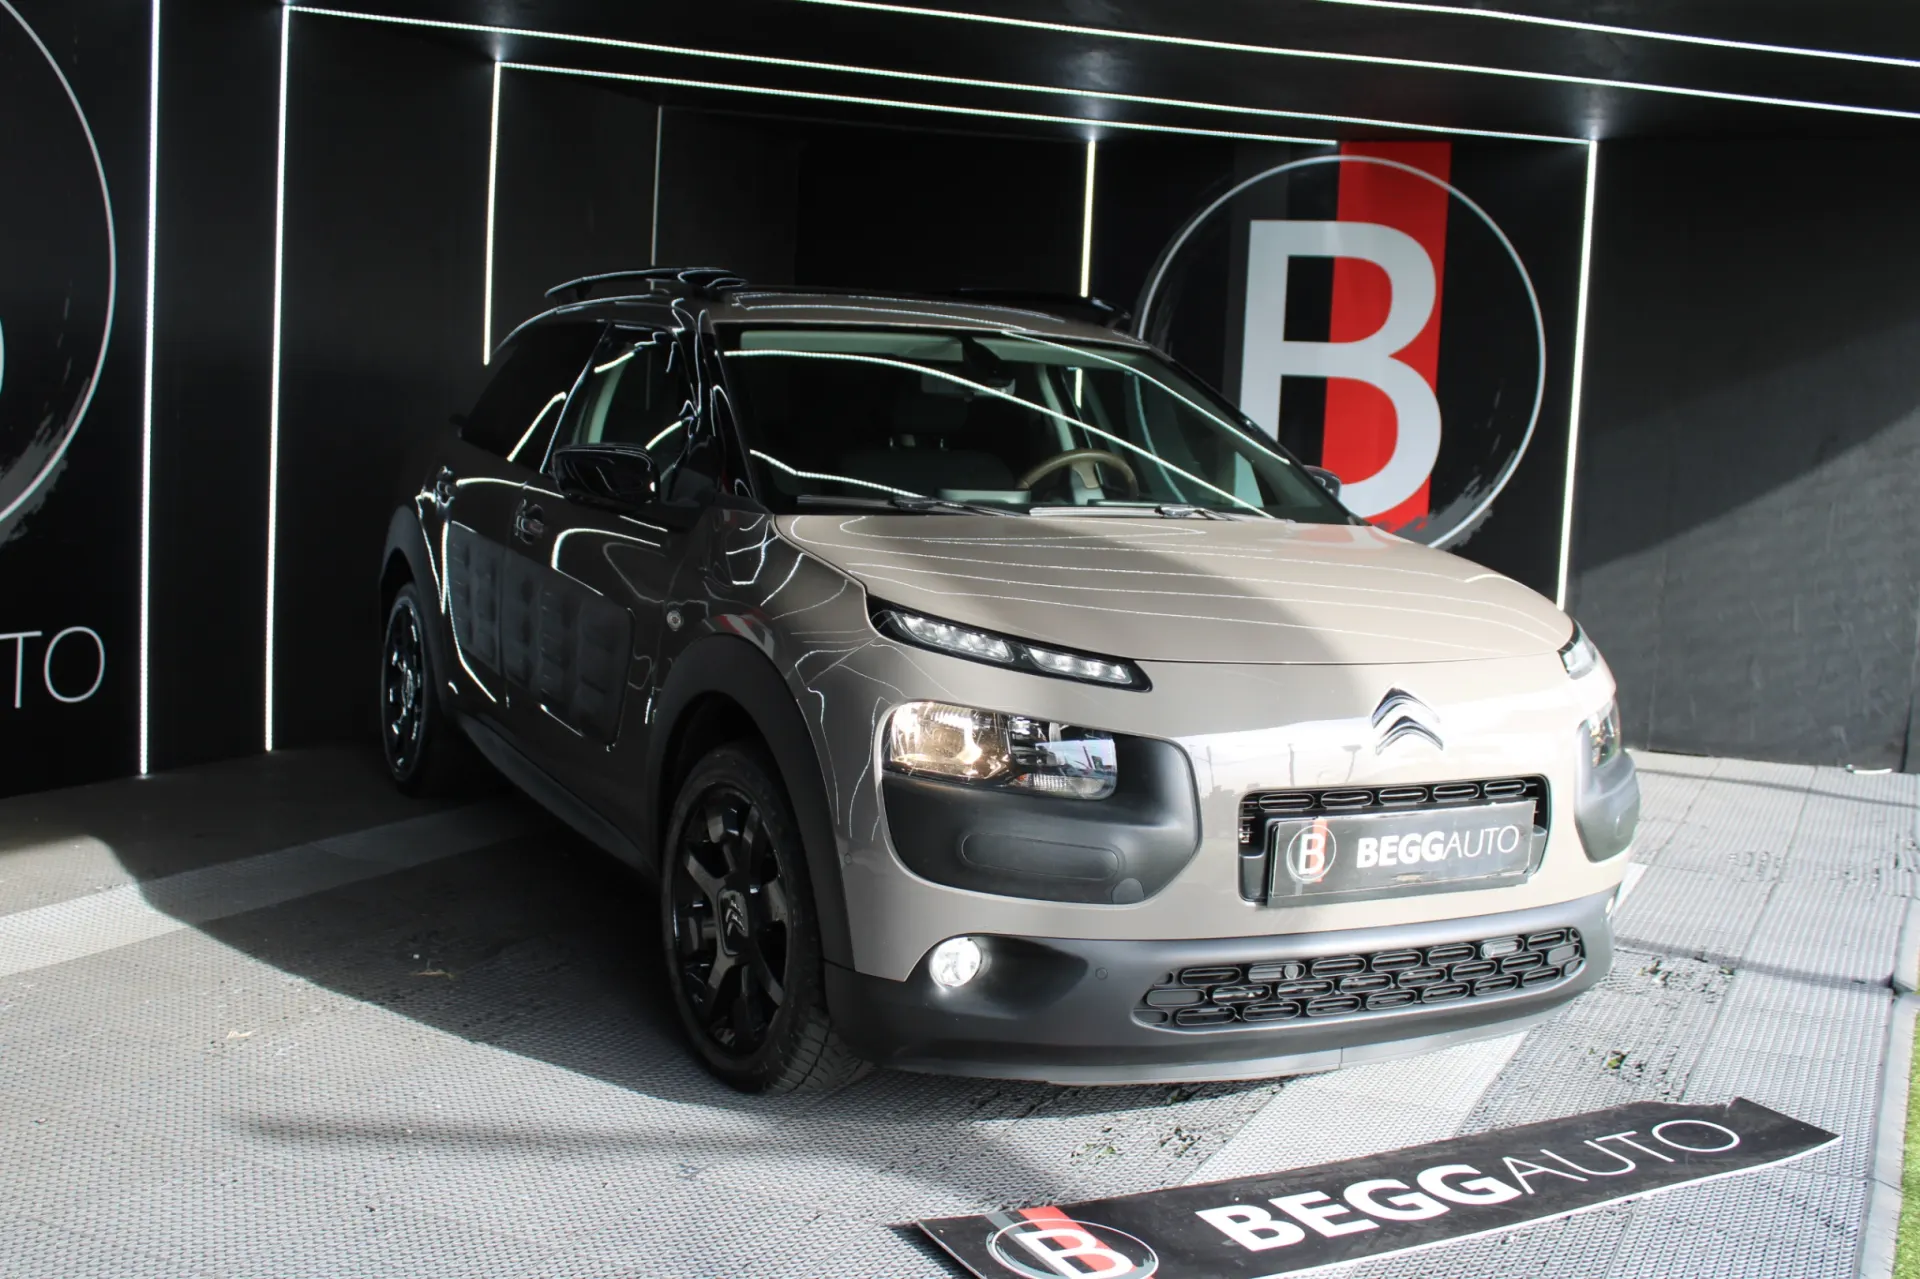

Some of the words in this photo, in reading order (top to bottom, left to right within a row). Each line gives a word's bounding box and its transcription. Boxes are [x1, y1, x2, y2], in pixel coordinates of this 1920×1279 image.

[1236, 219, 1442, 520] B
[1298, 833, 1325, 875] B
[1356, 825, 1520, 869] BEGGAUTO
[1014, 1228, 1133, 1279] B
[1194, 1119, 1741, 1252] BEGGAUTO
